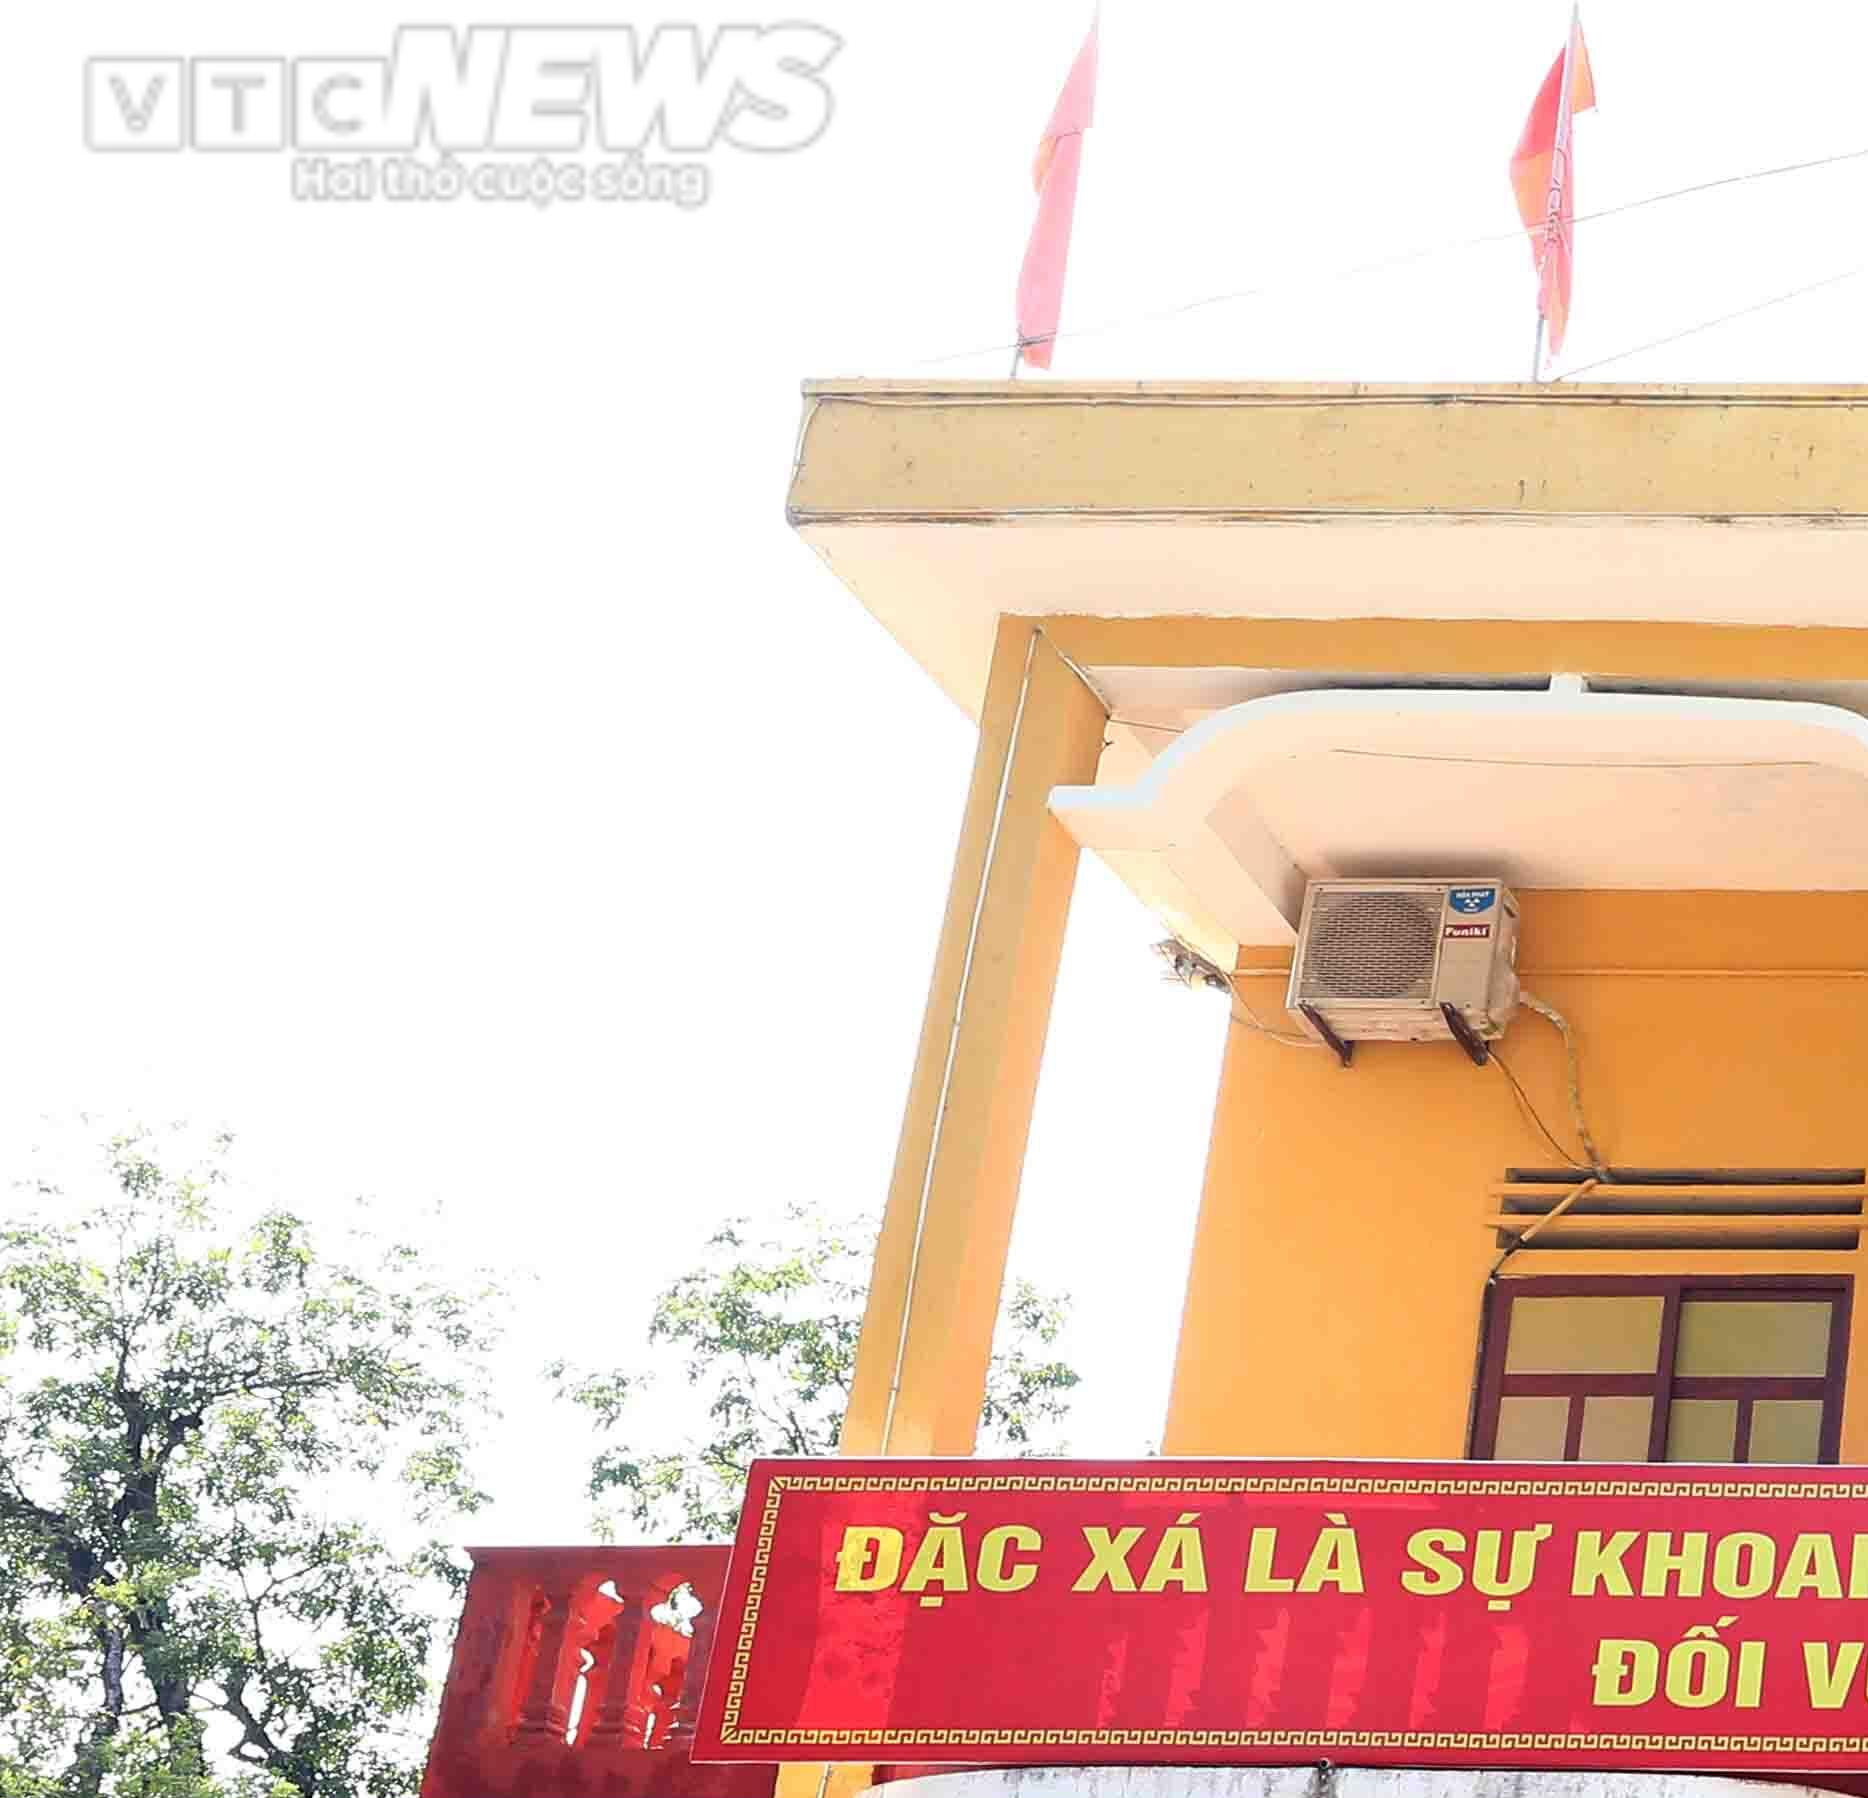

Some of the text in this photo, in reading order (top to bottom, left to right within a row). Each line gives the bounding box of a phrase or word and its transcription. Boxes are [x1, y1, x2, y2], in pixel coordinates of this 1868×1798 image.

[834, 1513, 1041, 1607] ĐẶC
[1072, 1513, 1208, 1592] XÁ
[1245, 1514, 1364, 1592] LÀ
[1402, 1524, 1553, 1610] SỰ
[1592, 1616, 1766, 1708] ĐỐI
